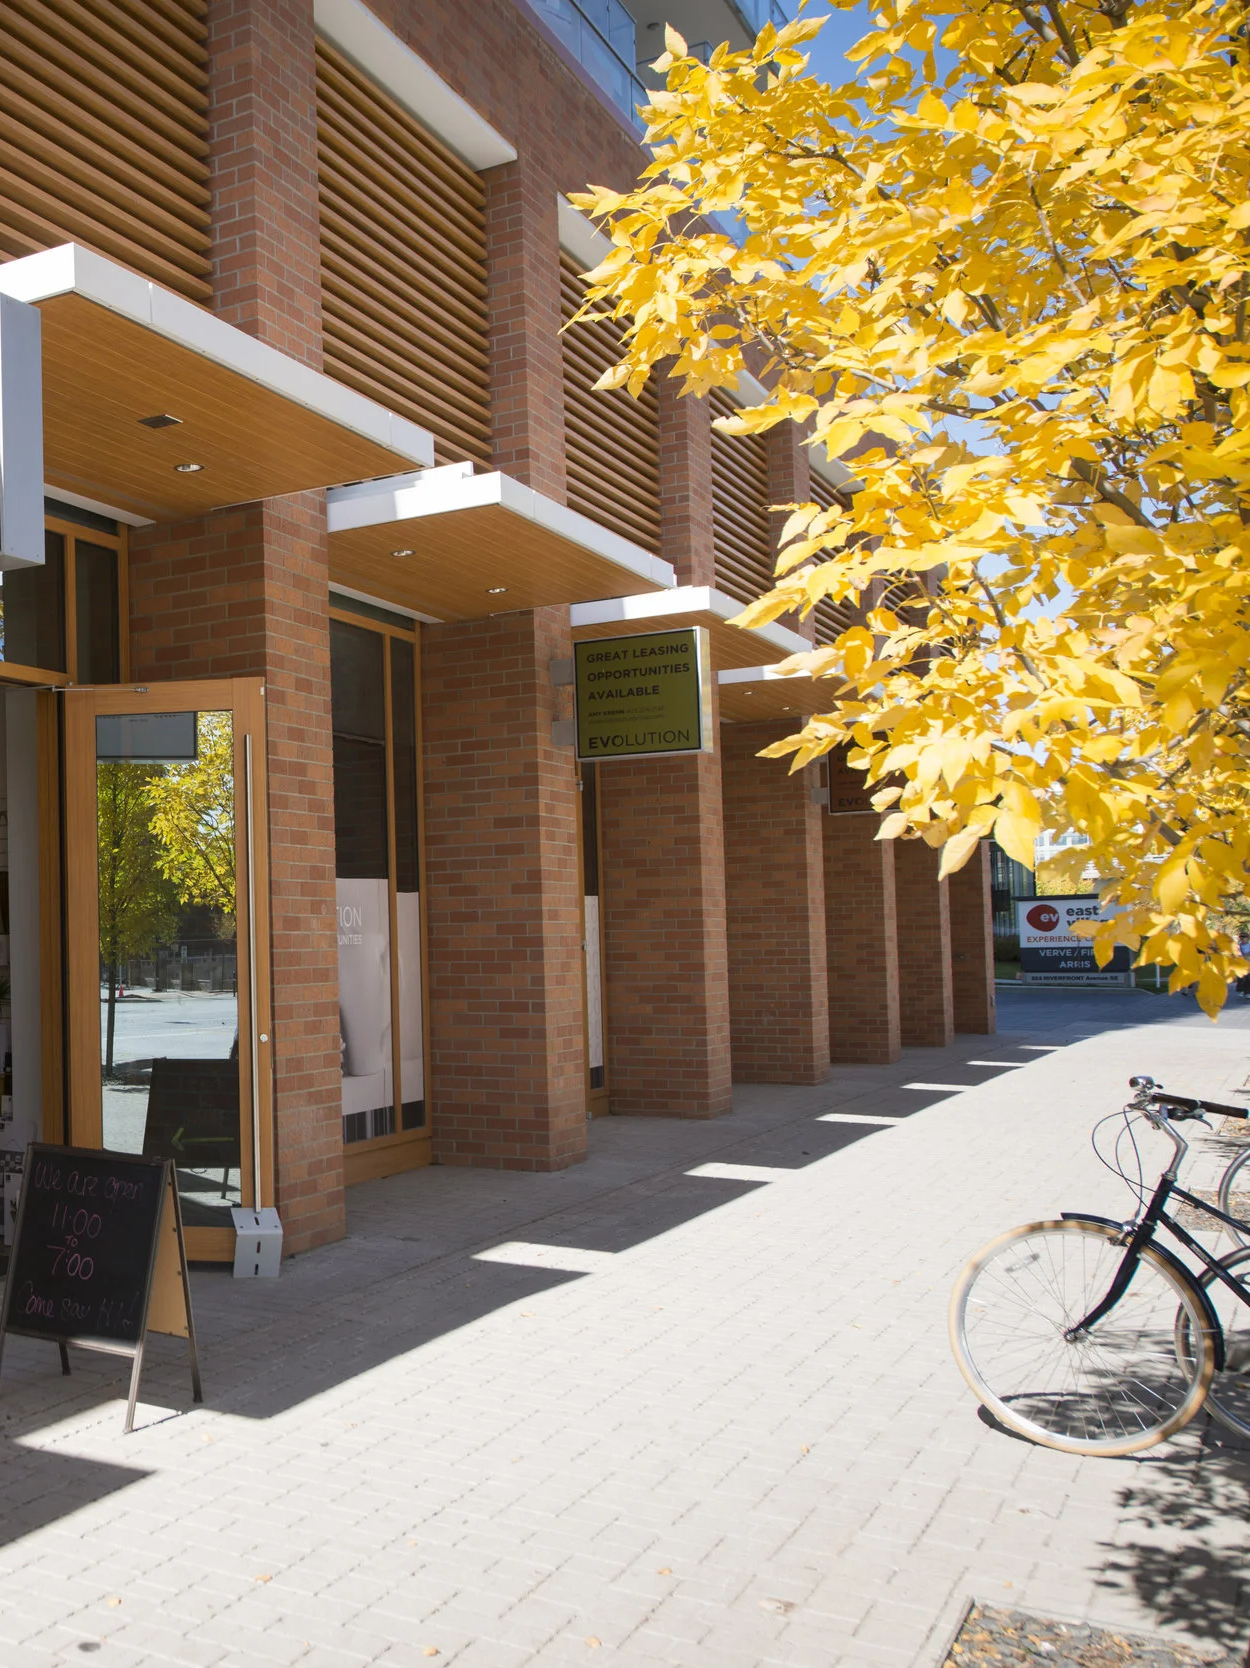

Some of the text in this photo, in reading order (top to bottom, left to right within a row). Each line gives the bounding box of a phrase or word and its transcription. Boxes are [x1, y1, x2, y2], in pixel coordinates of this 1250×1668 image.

[586, 643, 689, 664] GREAT LEASING
[586, 663, 690, 683] OPPORTUNITIES
[588, 685, 660, 701] AVAILABLE
[588, 729, 690, 749] EVOLUTION
[336, 906, 362, 928] ION
[1040, 912, 1059, 923] ev
[1066, 905, 1099, 917] east
[1026, 935, 1081, 943] EXPERIENCE
[1039, 949, 1072, 957] VERVE
[1059, 960, 1091, 969] ARRIS
[34, 1162, 62, 1191] We
[51, 1203, 102, 1239] 11:00
[45, 1244, 94, 1281] 7:00
[15, 1280, 55, 1319] Come
